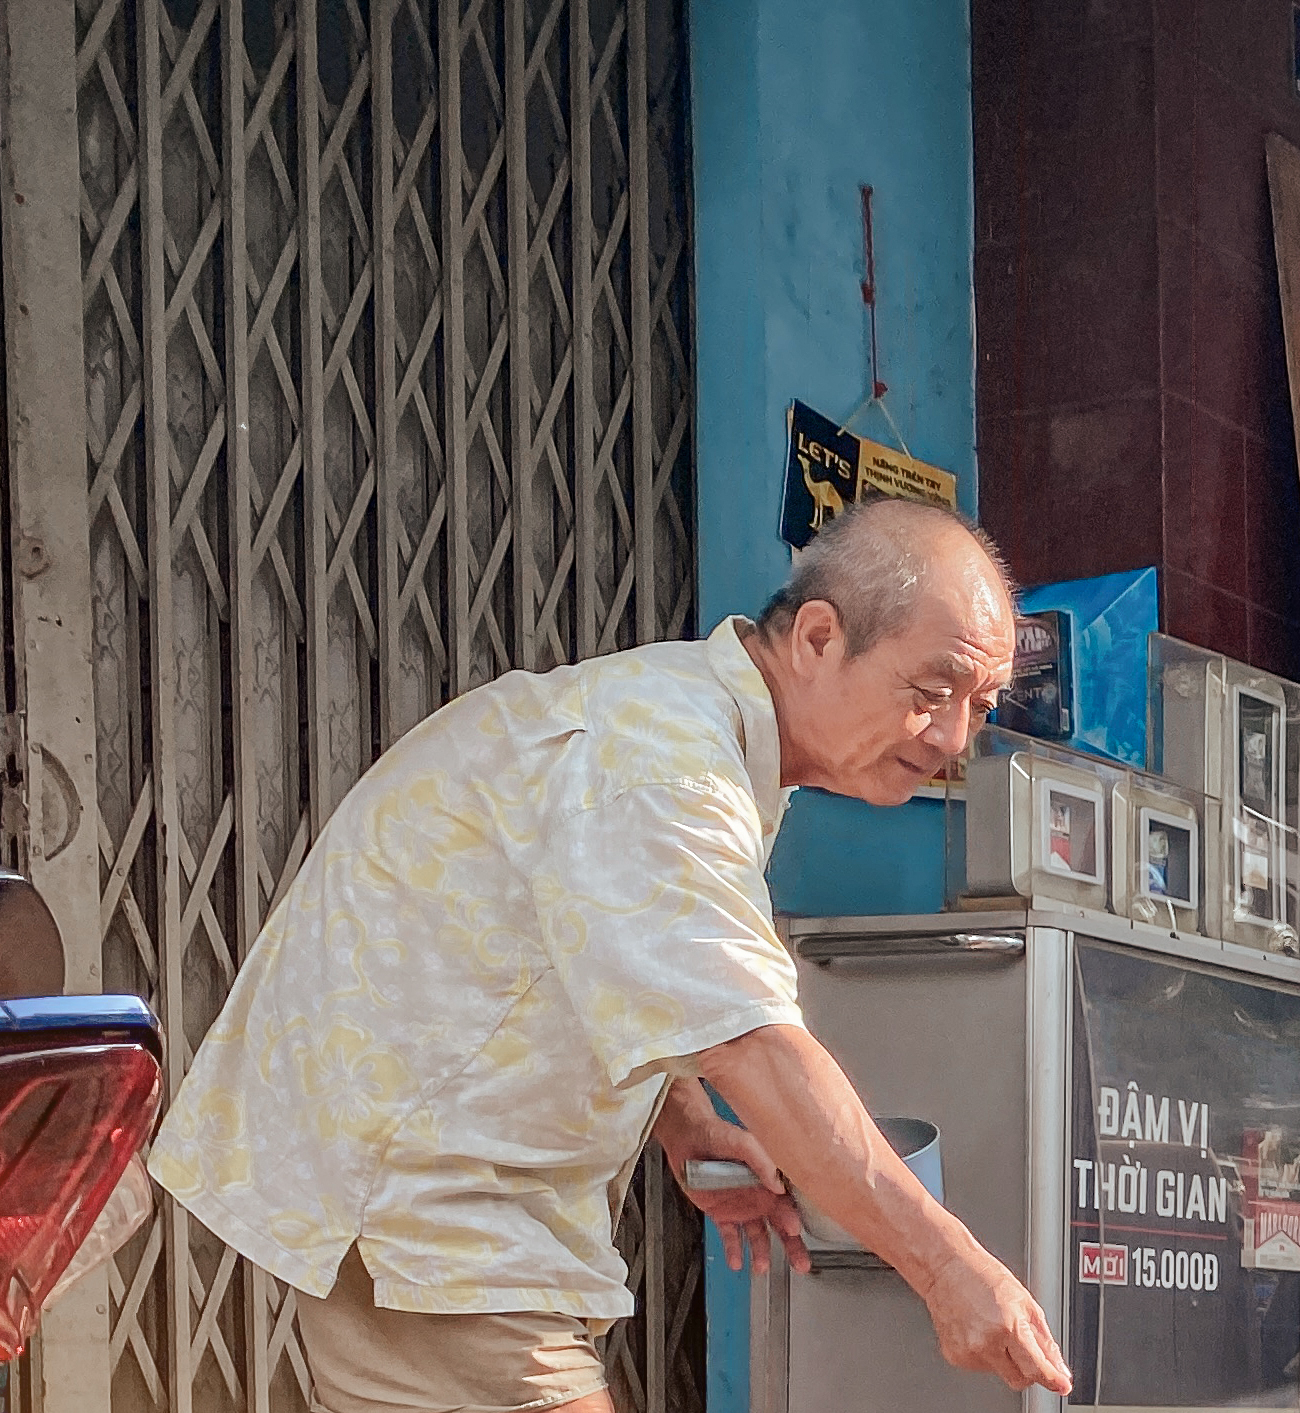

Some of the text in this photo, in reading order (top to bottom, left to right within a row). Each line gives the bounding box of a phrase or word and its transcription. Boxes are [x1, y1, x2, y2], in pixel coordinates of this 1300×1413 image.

[798, 432, 851, 479] LET'S
[1099, 1081, 1210, 1160] ĐẬM VỊ
[1073, 1155, 1228, 1224] THỜI GIAN
[1083, 1246, 1219, 1292] MỚI 15.000Đ
